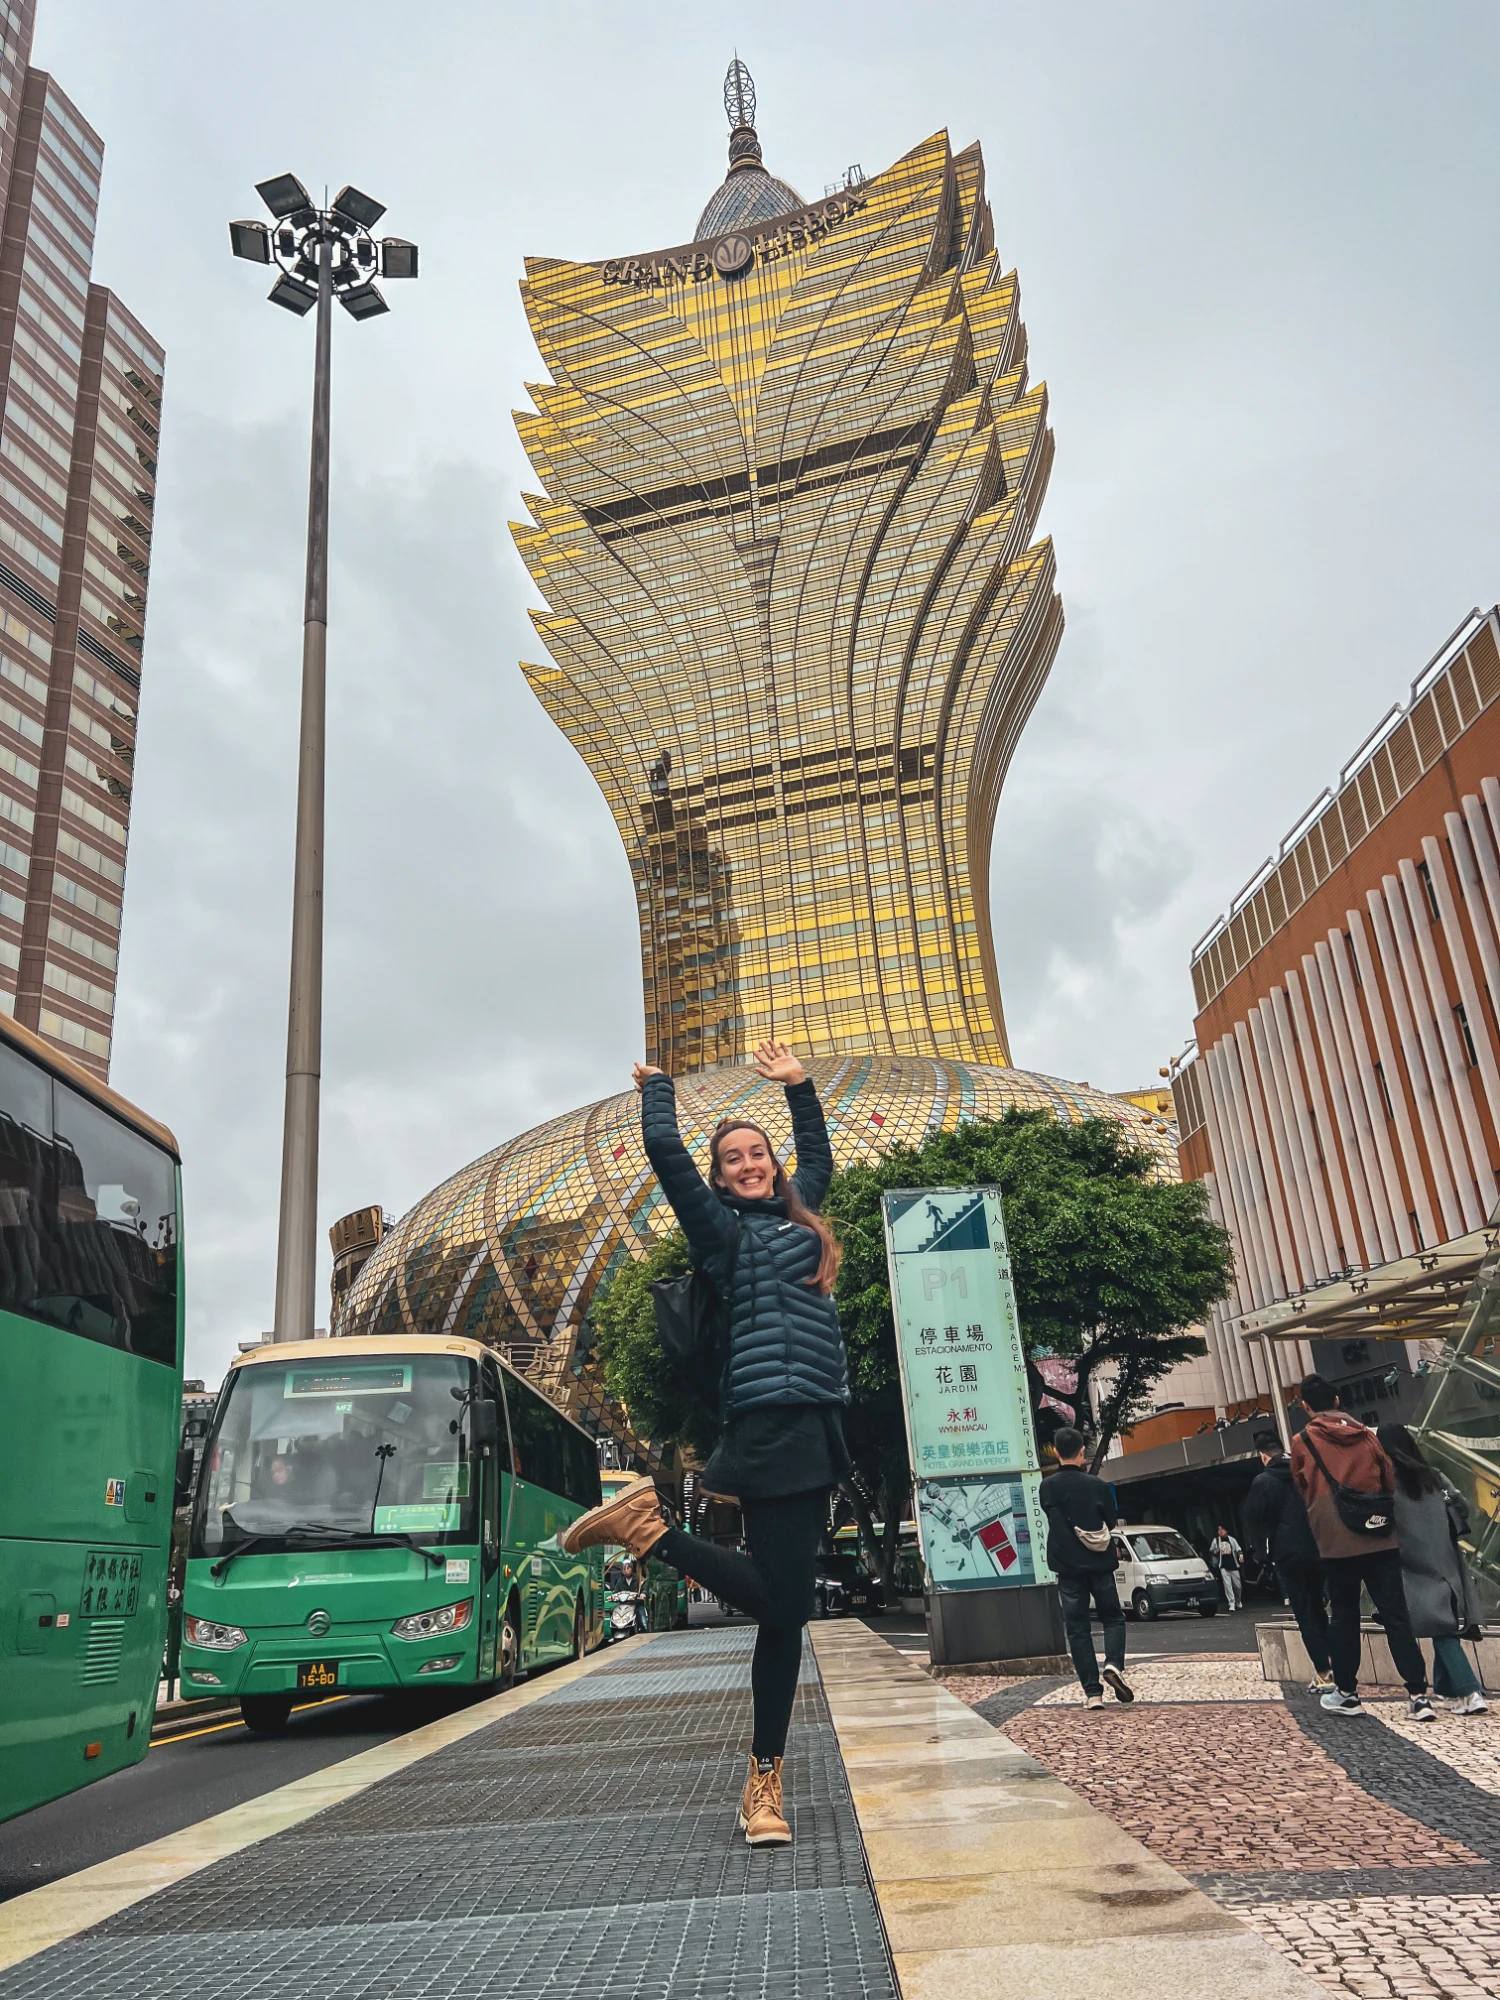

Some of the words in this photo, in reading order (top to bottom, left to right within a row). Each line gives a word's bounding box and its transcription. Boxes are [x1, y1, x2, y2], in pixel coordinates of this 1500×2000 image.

[600, 252, 710, 281] GRAND
[754, 192, 864, 252] LISBOA
[921, 1266, 968, 1301] P1
[920, 1324, 984, 1345] 停車場
[915, 1343, 993, 1355] ESTACIONAMENTO
[935, 1365, 977, 1384] 花園
[938, 1384, 978, 1394] JARDIM
[947, 1407, 978, 1423] 永利
[938, 1425, 961, 1434] WYNN
[962, 1423, 988, 1432] MACAU
[1005, 1293, 1022, 1372] PASSAGEM
[1031, 1486, 1047, 1562] PEDONAL
[924, 1461, 948, 1470] HOTEL
[949, 1459, 975, 1468] GRAND
[976, 1457, 1011, 1467] EMPEROR
[1370, 1514, 1388, 1524] NIKE
[83, 1586, 136, 1613] 有限公司
[310, 1663, 325, 1675] AA
[301, 1673, 335, 1687] 15-80
